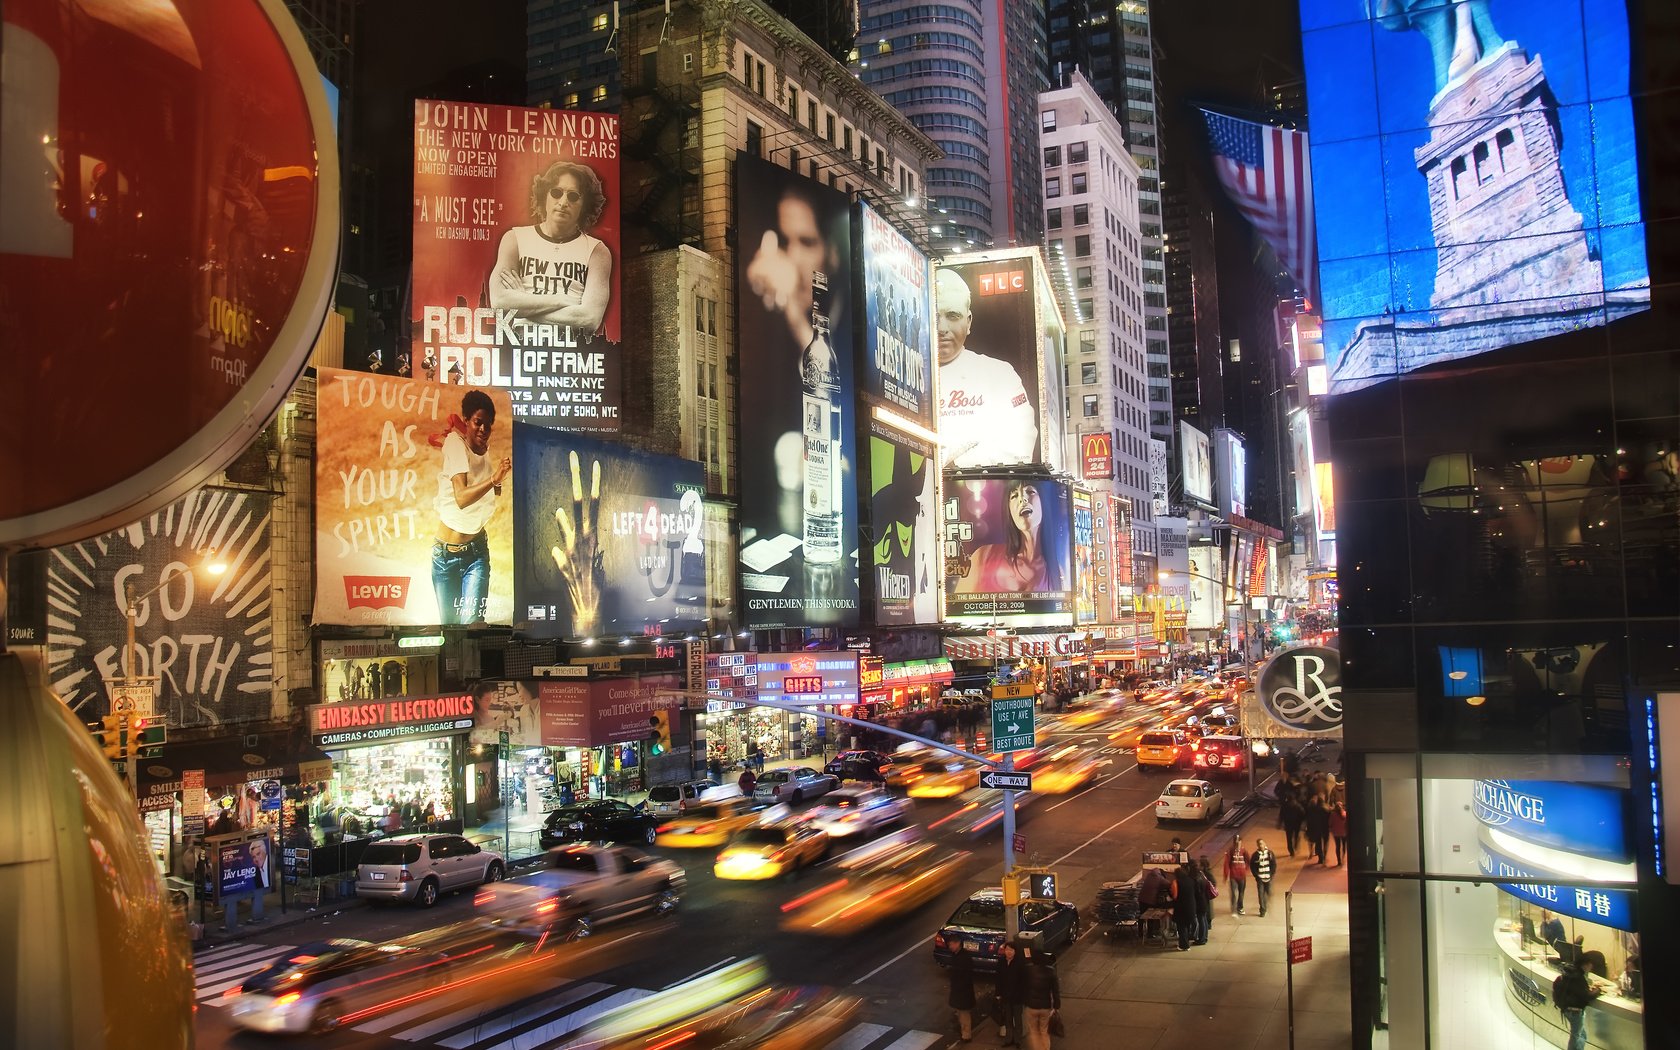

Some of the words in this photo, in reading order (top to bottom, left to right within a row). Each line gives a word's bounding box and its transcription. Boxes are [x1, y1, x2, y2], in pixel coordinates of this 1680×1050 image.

[418, 102, 488, 131] JOHN
[507, 109, 618, 140] LENNON:
[418, 129, 445, 147] THE
[452, 131, 481, 149] NEW
[489, 134, 525, 152] YORK
[532, 137, 563, 156] CITY
[570, 140, 617, 160] YEARS
[418, 148, 450, 162] NOW
[458, 150, 497, 166] OPEN
[418, 163, 446, 175] LIMITED
[449, 165, 497, 178] ENGAGEMENT
[416, 196, 428, 222] "A
[435, 196, 466, 224] MUST
[436, 227, 446, 239] KEN
[890, 231, 924, 272] CROWD
[519, 256, 549, 276] NEW
[554, 261, 589, 284] YORK
[533, 277, 573, 295] CITY
[981, 276, 1023, 292] TLC
[423, 306, 520, 346] ROCK
[524, 324, 578, 348] HALL
[440, 346, 532, 387] ROLL
[524, 351, 548, 373] OF
[552, 352, 605, 375] FAME
[874, 326, 904, 384] JERSEY
[905, 346, 925, 394] BOYS
[537, 377, 578, 388] ANNEX
[582, 378, 605, 390] NYC
[884, 379, 898, 394] BEST
[334, 375, 440, 420] TOUGH
[539, 392, 550, 402] A
[556, 392, 602, 402] WEEK
[948, 390, 984, 408] Boss
[512, 405, 528, 416] THE
[531, 406, 558, 416] HEART
[560, 406, 571, 416] OF
[574, 406, 599, 419] SOHO,
[602, 406, 618, 418] NYC
[380, 421, 418, 460] AS
[1090, 462, 1104, 470] 24
[340, 464, 418, 510] YOUR
[613, 512, 642, 535] LEFT
[643, 506, 658, 542] 4
[660, 513, 692, 534] DEAD
[333, 510, 424, 558] SPIRIT.
[1160, 534, 1186, 543] MAXIMUM
[1095, 501, 1108, 594] PALACE
[1160, 542, 1186, 550] PERFORMANCE
[1160, 549, 1174, 557] LIVES
[640, 556, 666, 569] L4D.COM
[946, 565, 970, 578] City
[114, 561, 195, 627] GO
[1162, 584, 1188, 596] maxell
[749, 600, 804, 610] GENTLEMEN,
[805, 599, 823, 608] THIS
[824, 600, 831, 608] IS
[832, 600, 857, 609] VODKA.
[964, 602, 998, 610] OCTOBER
[10, 628, 34, 640] SQUARE
[344, 645, 375, 656] BROADWAY
[1002, 636, 1050, 658] TREE
[94, 633, 241, 702] FORTH
[720, 656, 730, 666] GIFT
[734, 656, 744, 664] NYC
[816, 660, 855, 670] BROADWAY
[734, 666, 744, 676] GIFT
[746, 666, 756, 674] NYC
[860, 670, 882, 684] STEAKS
[708, 680, 718, 689] NYC
[746, 676, 756, 685] GIFT
[785, 678, 821, 693] GIFTS
[1293, 655, 1342, 712] R
[542, 686, 564, 694] American
[564, 686, 574, 694] Girl
[574, 686, 587, 694] Place
[609, 688, 628, 700] Come
[629, 686, 649, 699] spend
[1006, 687, 1020, 696] NEW
[599, 705, 618, 720] you'll
[618, 702, 646, 714] never
[708, 702, 720, 712] NYC
[722, 701, 732, 710] GIFT
[994, 698, 1032, 711] SOUTHBOUND
[318, 703, 386, 730] EMBASSY
[390, 695, 474, 722] ELECTRONICS
[998, 712, 1010, 722] USE
[1012, 712, 1016, 720] 7
[1018, 710, 1028, 720] AVE
[322, 732, 362, 745] CAMERAS
[368, 726, 415, 739] COMPUTERS
[420, 722, 454, 733] LUGGAGE
[996, 739, 1012, 748] BEST
[1014, 736, 1032, 747] ROUTE
[246, 767, 284, 780] SMILER'S
[988, 776, 1002, 784] ONE
[1009, 777, 1026, 785] WAY
[142, 794, 174, 808] ACCESS
[1475, 782, 1545, 824] EXCHANGE
[223, 870, 236, 880] JAY
[236, 866, 256, 877] LENO
[1575, 888, 1611, 918] 両替
